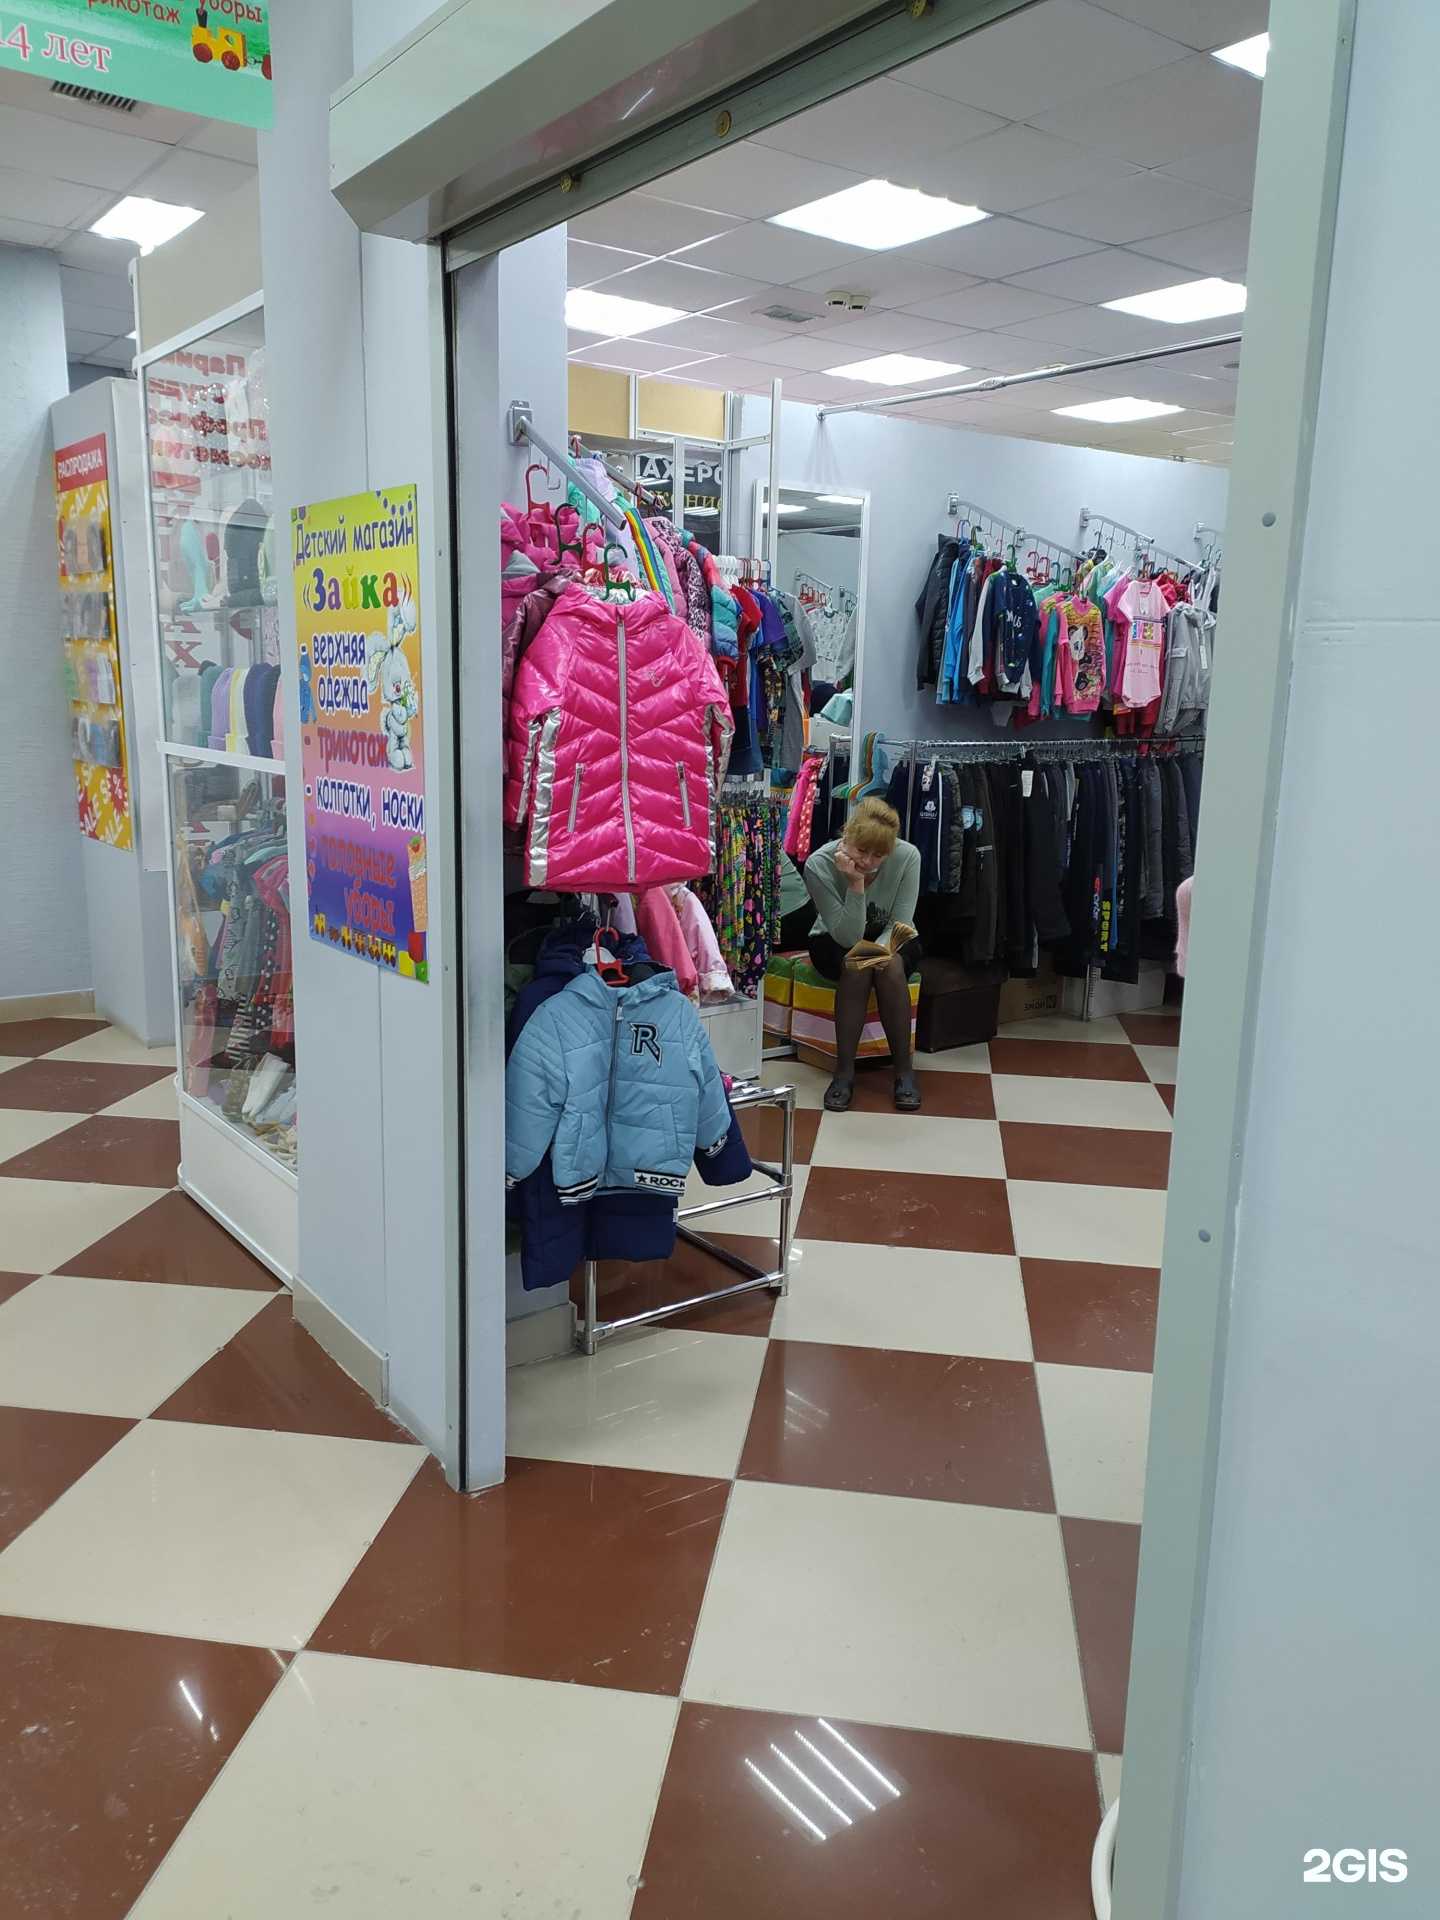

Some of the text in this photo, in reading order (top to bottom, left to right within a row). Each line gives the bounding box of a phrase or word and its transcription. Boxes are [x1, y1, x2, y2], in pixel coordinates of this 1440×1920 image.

[0, 22, 112, 72] 4 лет
[295, 515, 414, 563] Детский магазин
[313, 633, 366, 675] верхняя
[318, 676, 369, 715] одежда
[317, 727, 390, 772] трикотаж
[382, 788, 425, 833] носки
[630, 1022, 662, 1068] R
